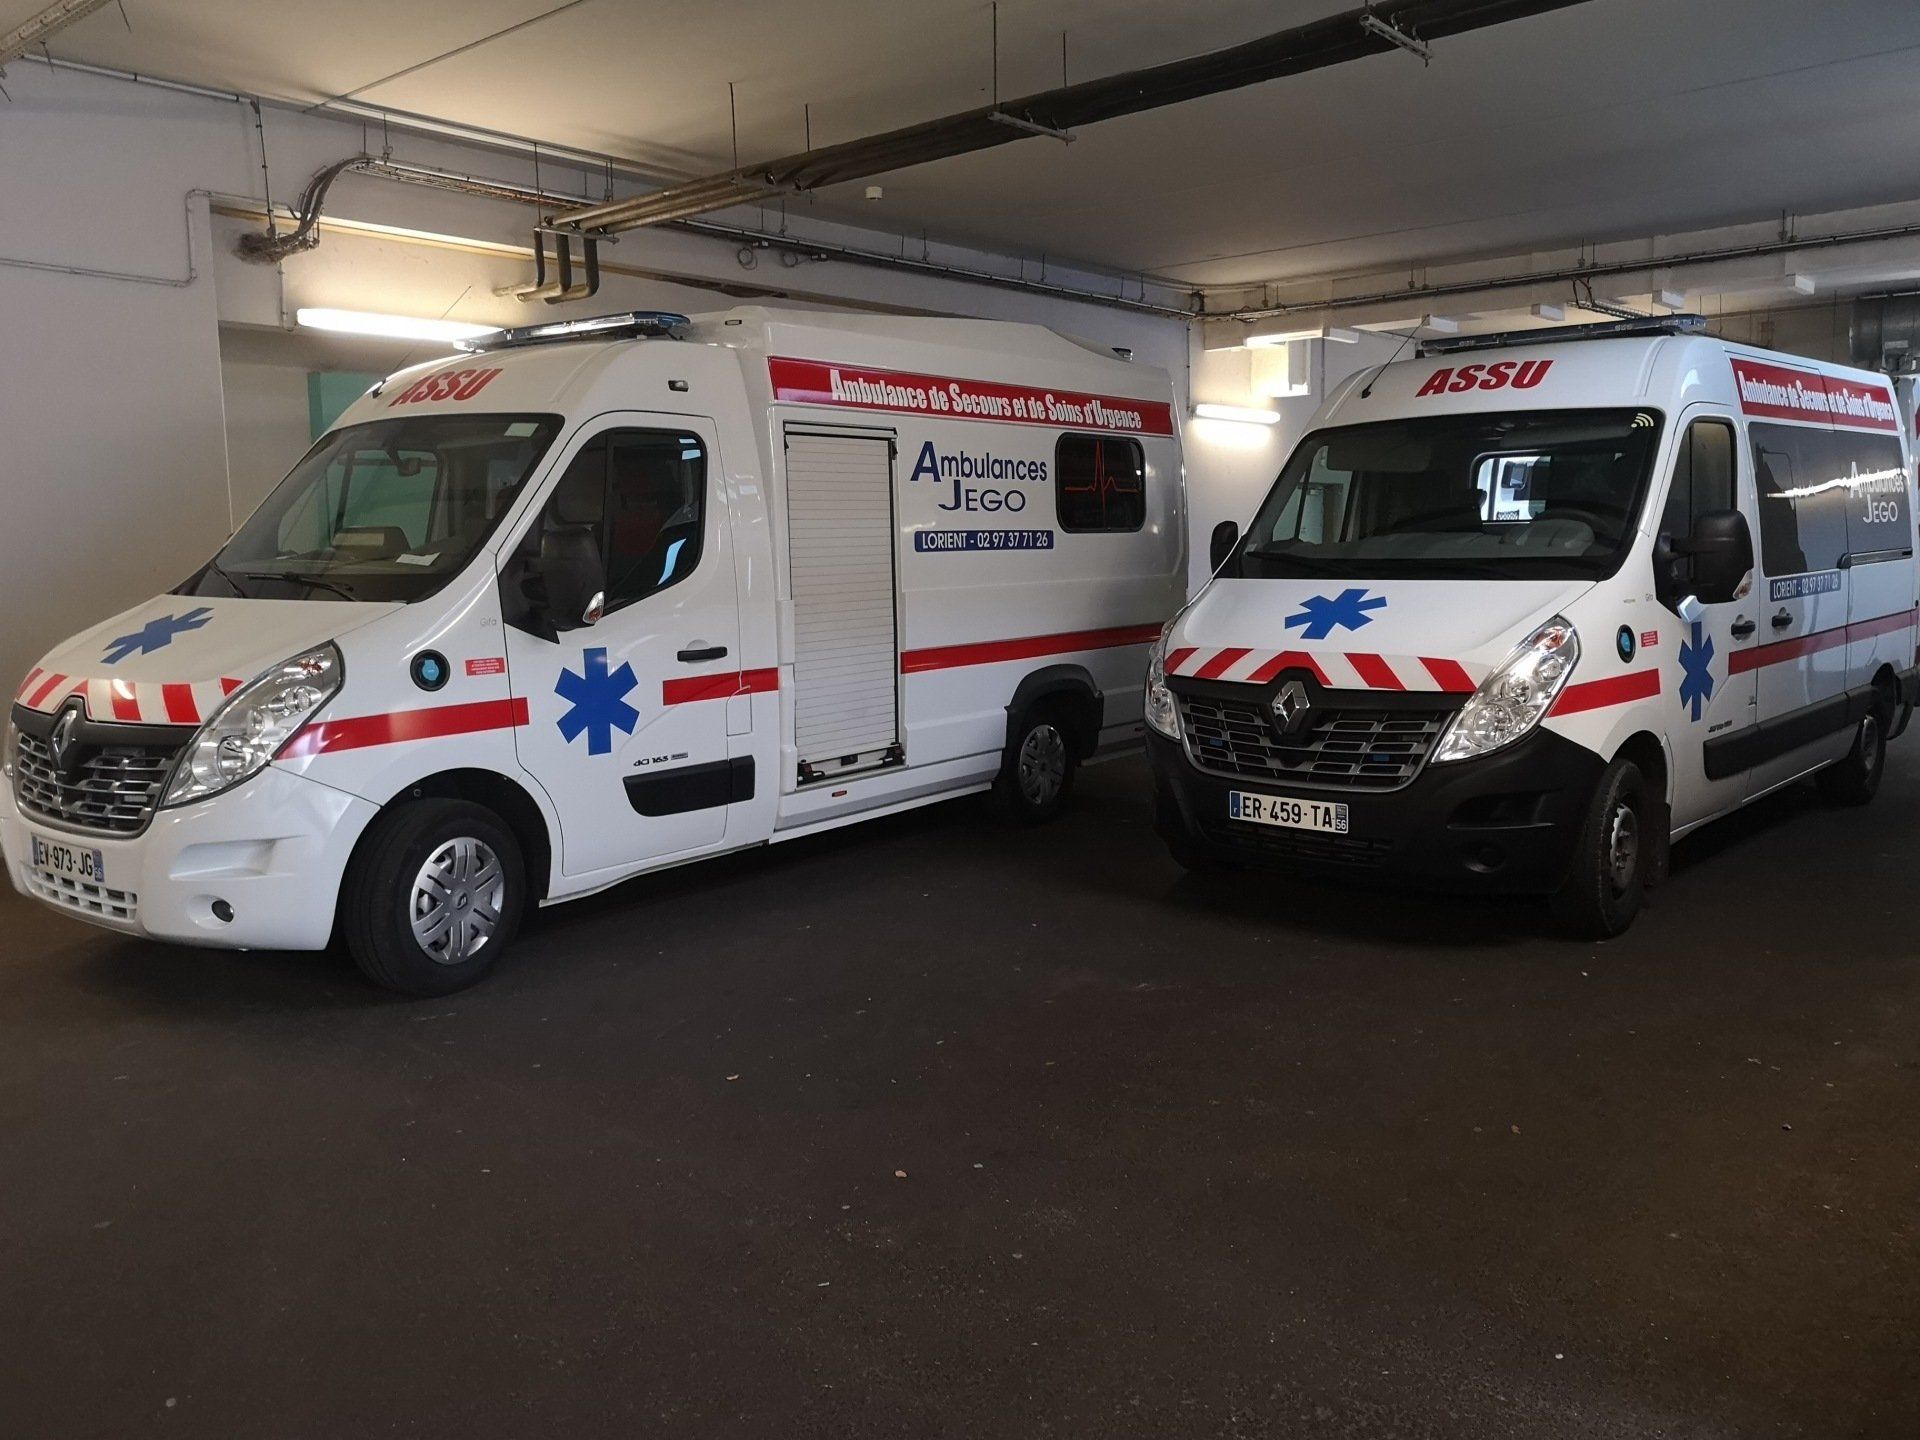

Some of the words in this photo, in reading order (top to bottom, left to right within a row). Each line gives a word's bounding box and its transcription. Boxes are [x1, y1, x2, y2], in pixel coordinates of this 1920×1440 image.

[388, 368, 503, 407] ASSU
[1415, 360, 1555, 398] ASSU
[1738, 371, 1789, 407] Ambulance
[830, 369, 927, 409] Ambulance
[929, 386, 950, 411] de
[949, 383, 1012, 416] Secours
[1013, 396, 1029, 419] et
[1028, 397, 1046, 420] de
[1045, 393, 1084, 424] Soins
[1083, 399, 1142, 430] d'Urgence
[910, 441, 1047, 482] Ambulances
[938, 479, 1026, 512] JEGO
[1862, 494, 1898, 523] JEGO
[922, 533, 967, 549] LORIENT
[977, 532, 990, 547] 02
[992, 532, 1005, 547] 97
[1008, 532, 1020, 547] 37
[1022, 532, 1034, 546] 71
[1036, 532, 1048, 546] 26
[1773, 580, 1797, 599] LORIENT
[1801, 577, 1809, 594] 02
[1810, 576, 1816, 592] 97
[1817, 575, 1824, 592] 37
[1242, 796, 1332, 828] ER-459-TA
[1336, 819, 1346, 830] 56
[38, 841, 93, 876] EV-973-JG
